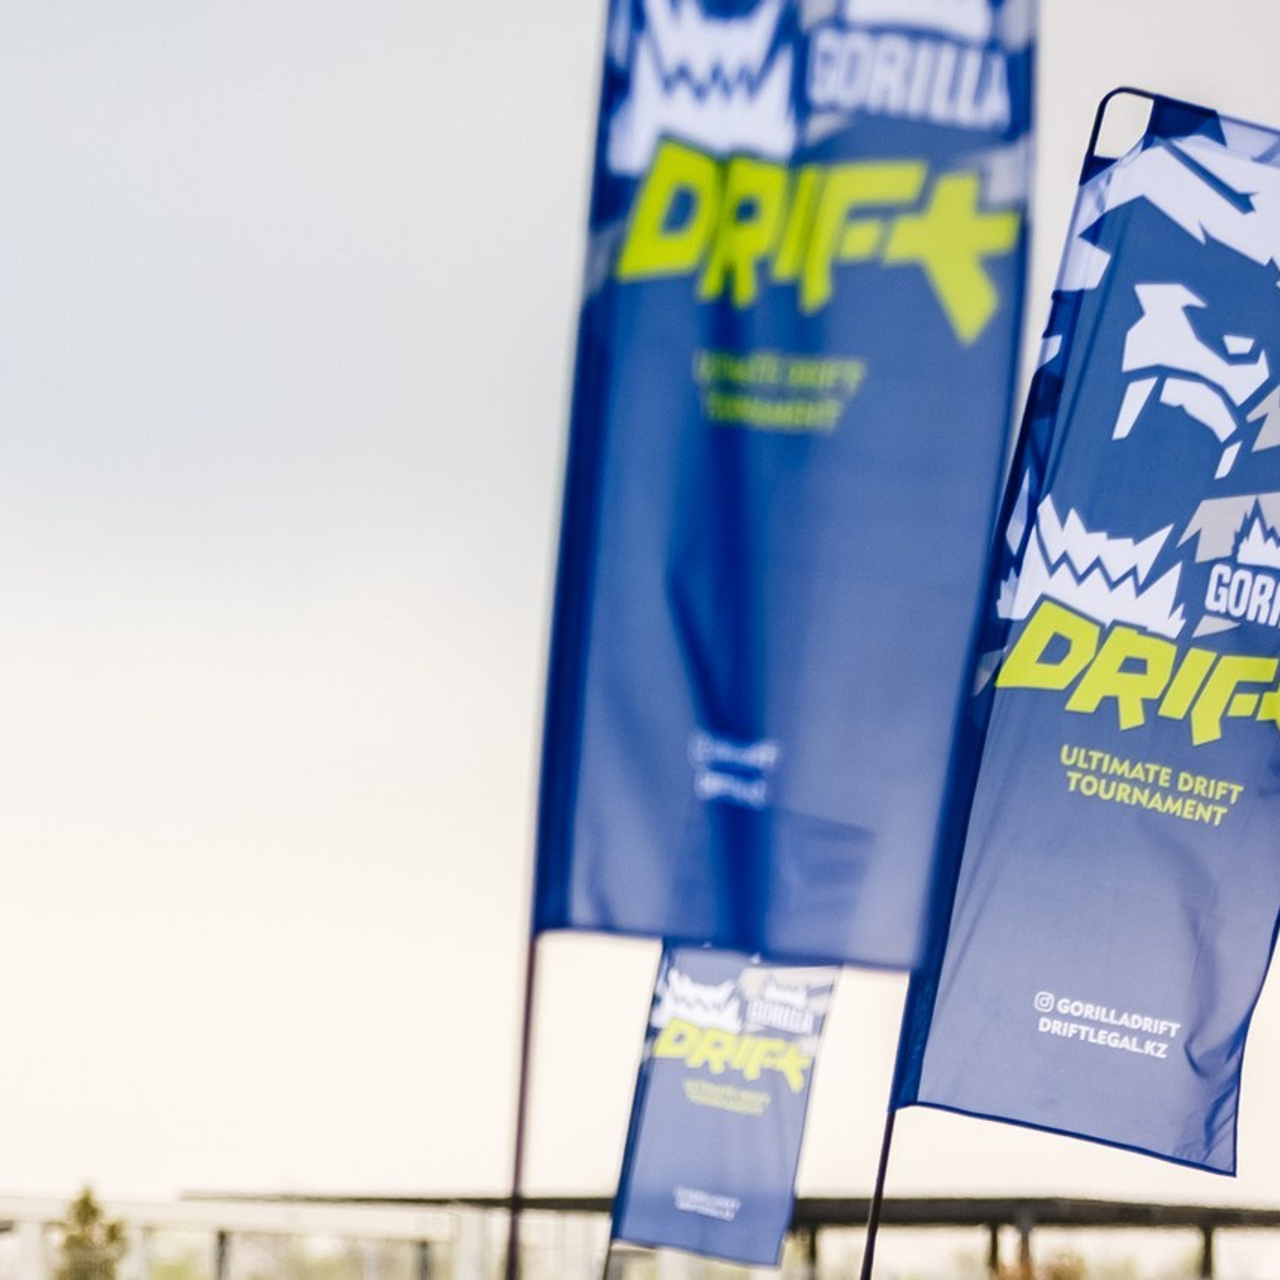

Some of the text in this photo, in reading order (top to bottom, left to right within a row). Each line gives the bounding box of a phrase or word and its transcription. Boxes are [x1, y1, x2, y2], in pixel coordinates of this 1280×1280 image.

[808, 27, 1010, 132] GORILLA
[617, 138, 1018, 345] DRIFT
[995, 600, 1280, 746] DRIF
[1060, 744, 1244, 804] ULTIMATE DRIFT
[1067, 771, 1228, 827] TOURNAMENT
[1038, 1017, 1168, 1059] DRIFTLEGAL.KZ
[1056, 998, 1181, 1038] GORILLADRIFT
[652, 1016, 811, 1094] DRIFT
